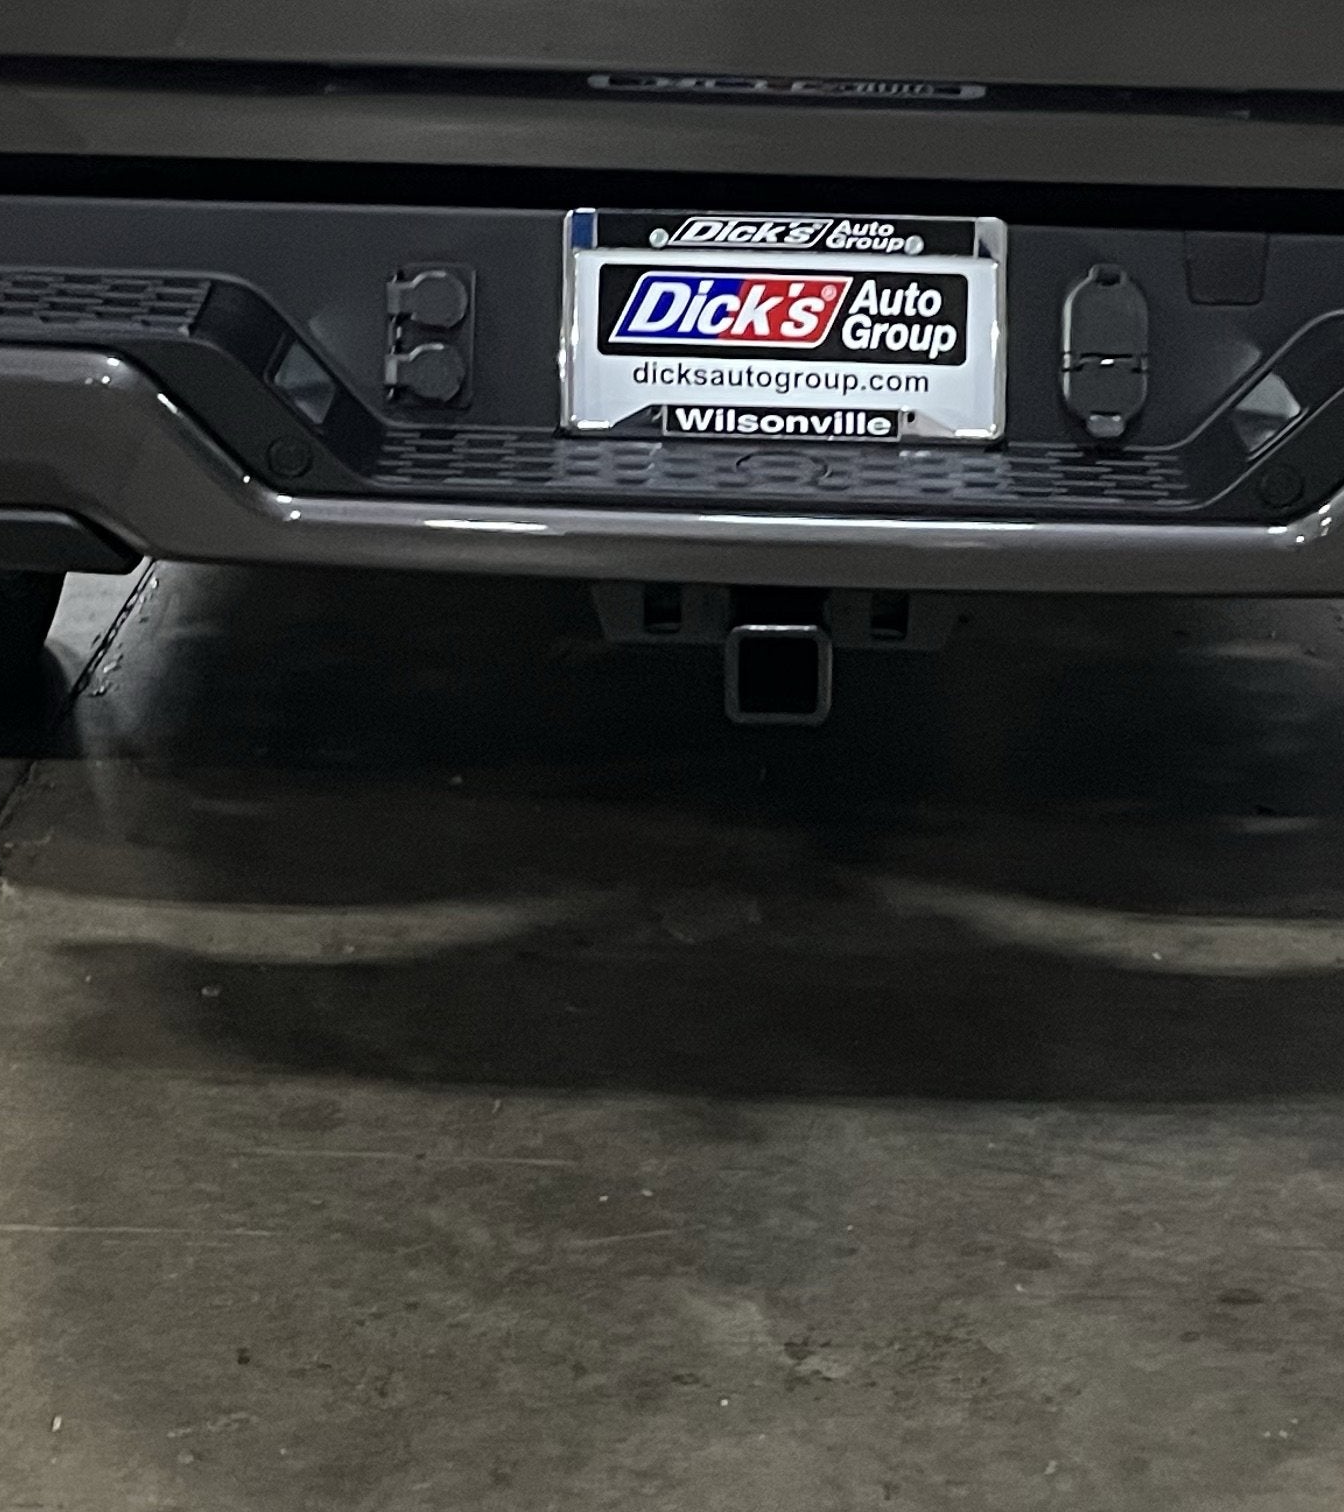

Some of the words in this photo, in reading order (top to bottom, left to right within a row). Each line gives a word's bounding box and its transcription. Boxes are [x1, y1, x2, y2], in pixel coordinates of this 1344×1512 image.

[678, 217, 819, 245] Dick's
[825, 234, 904, 254] Group
[835, 219, 895, 238] Auto
[627, 279, 825, 338] Dick's
[849, 280, 942, 318] Auto
[841, 313, 957, 359] Group
[632, 361, 929, 395] dicksautogroup.com
[675, 407, 892, 437] Wilsonville
